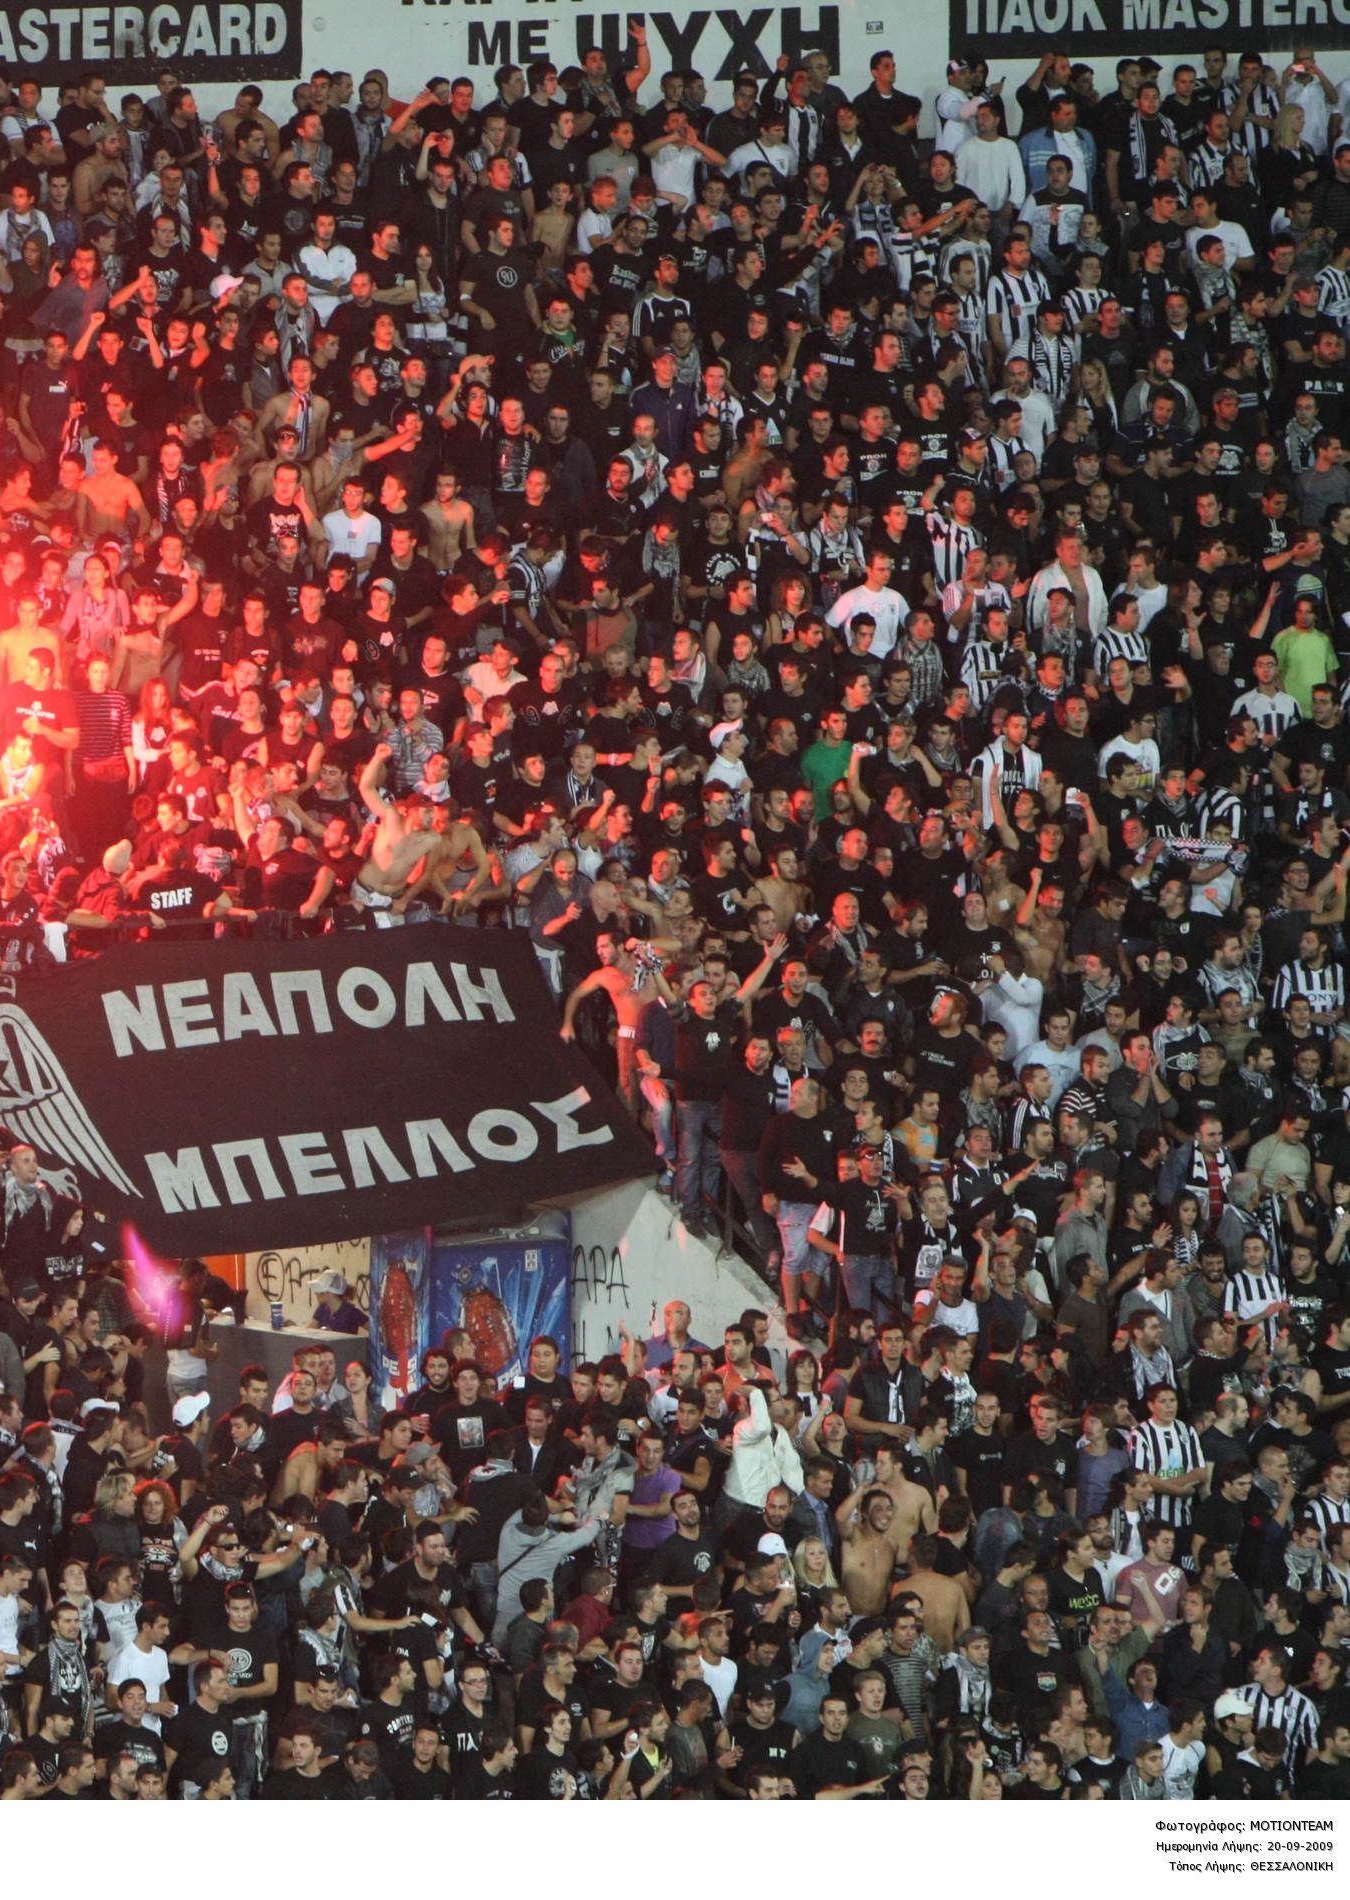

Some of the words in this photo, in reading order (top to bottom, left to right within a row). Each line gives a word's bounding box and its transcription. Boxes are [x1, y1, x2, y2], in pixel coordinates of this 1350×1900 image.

[467, 19, 550, 66] ΜΕ
[576, 6, 840, 82] ΨΥΧΗ
[150, 886, 194, 910] STAFF
[101, 962, 516, 1058] ΝΕΑΠΟΛΗ
[144, 1085, 615, 1215] ΜΠΕΛΛΟΣ
